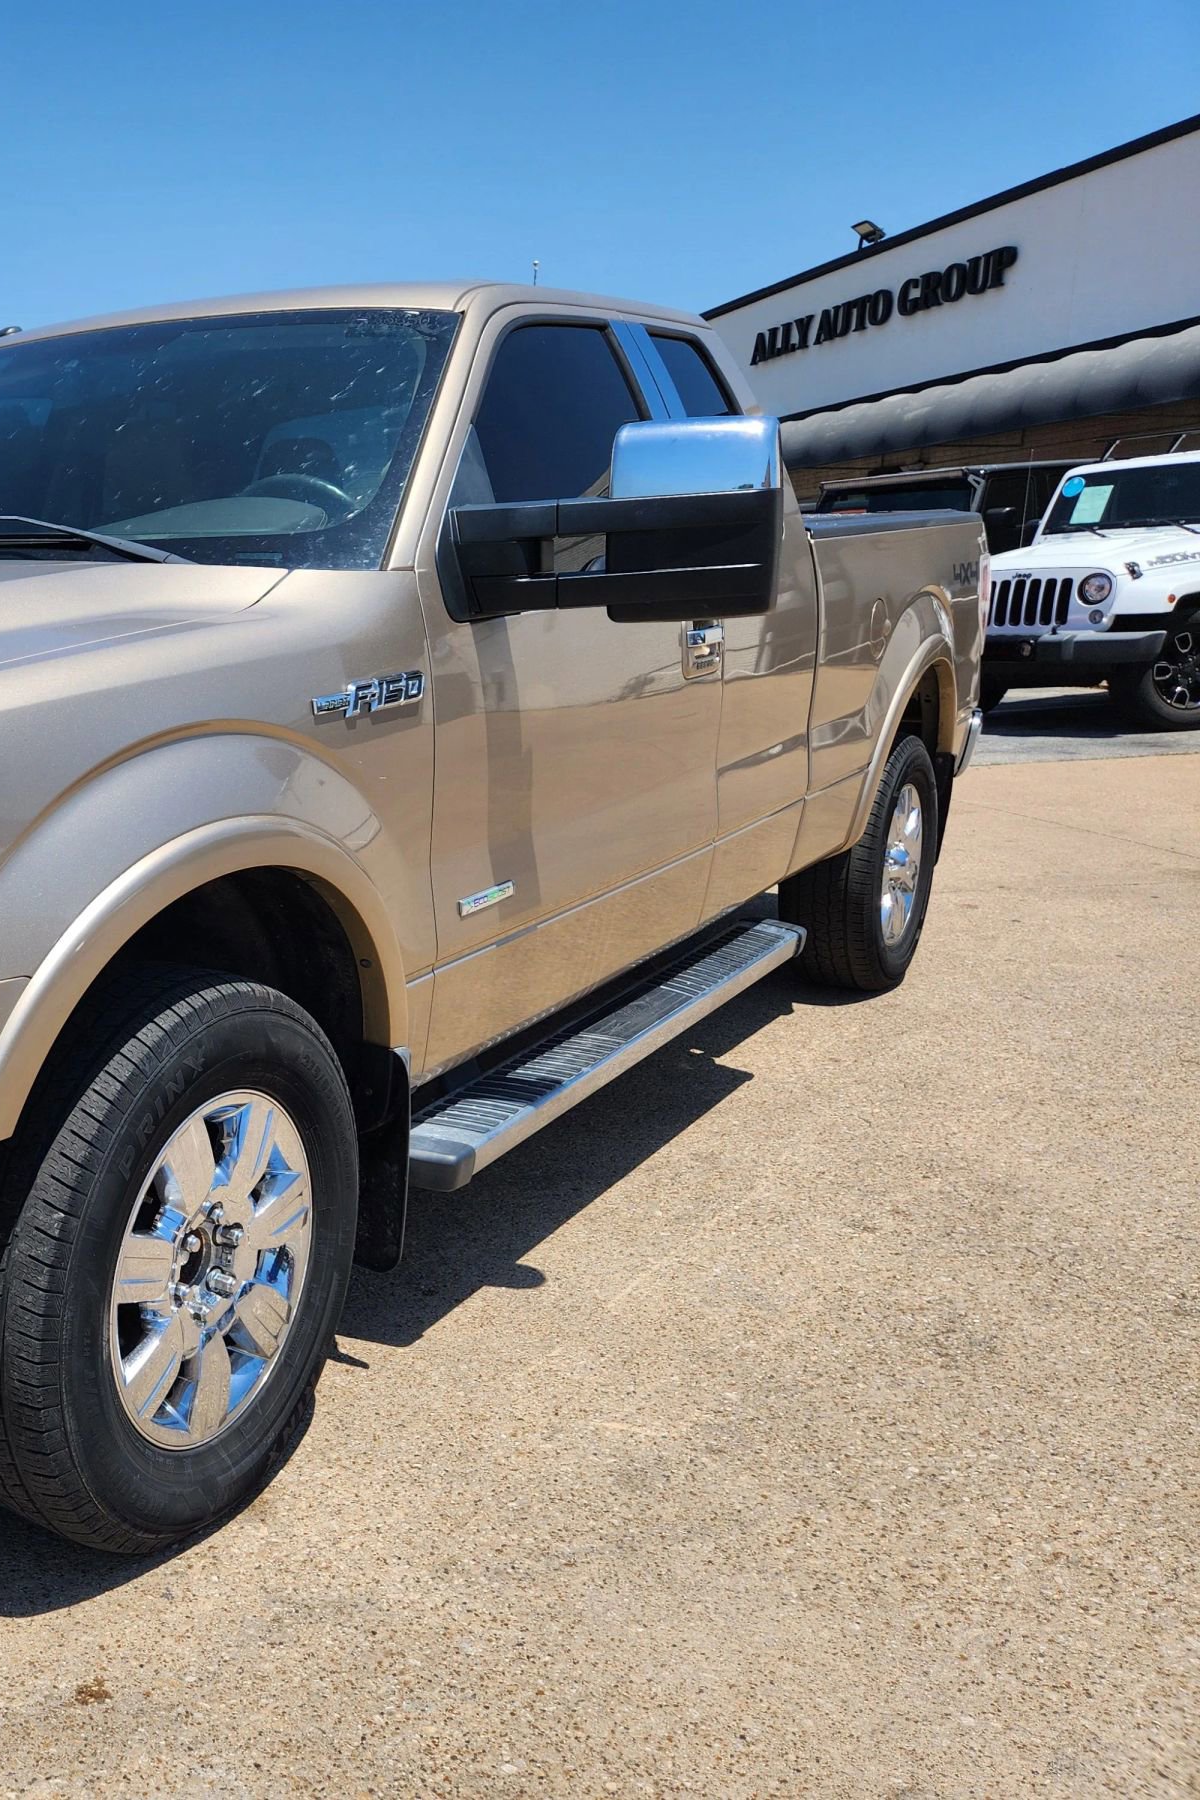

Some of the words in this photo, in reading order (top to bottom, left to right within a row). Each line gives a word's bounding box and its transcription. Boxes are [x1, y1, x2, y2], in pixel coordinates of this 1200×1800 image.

[750, 314, 815, 366] ALLY
[813, 289, 893, 345] AUTO
[897, 245, 1018, 316] GROUP
[1012, 572, 1033, 580] Jeep
